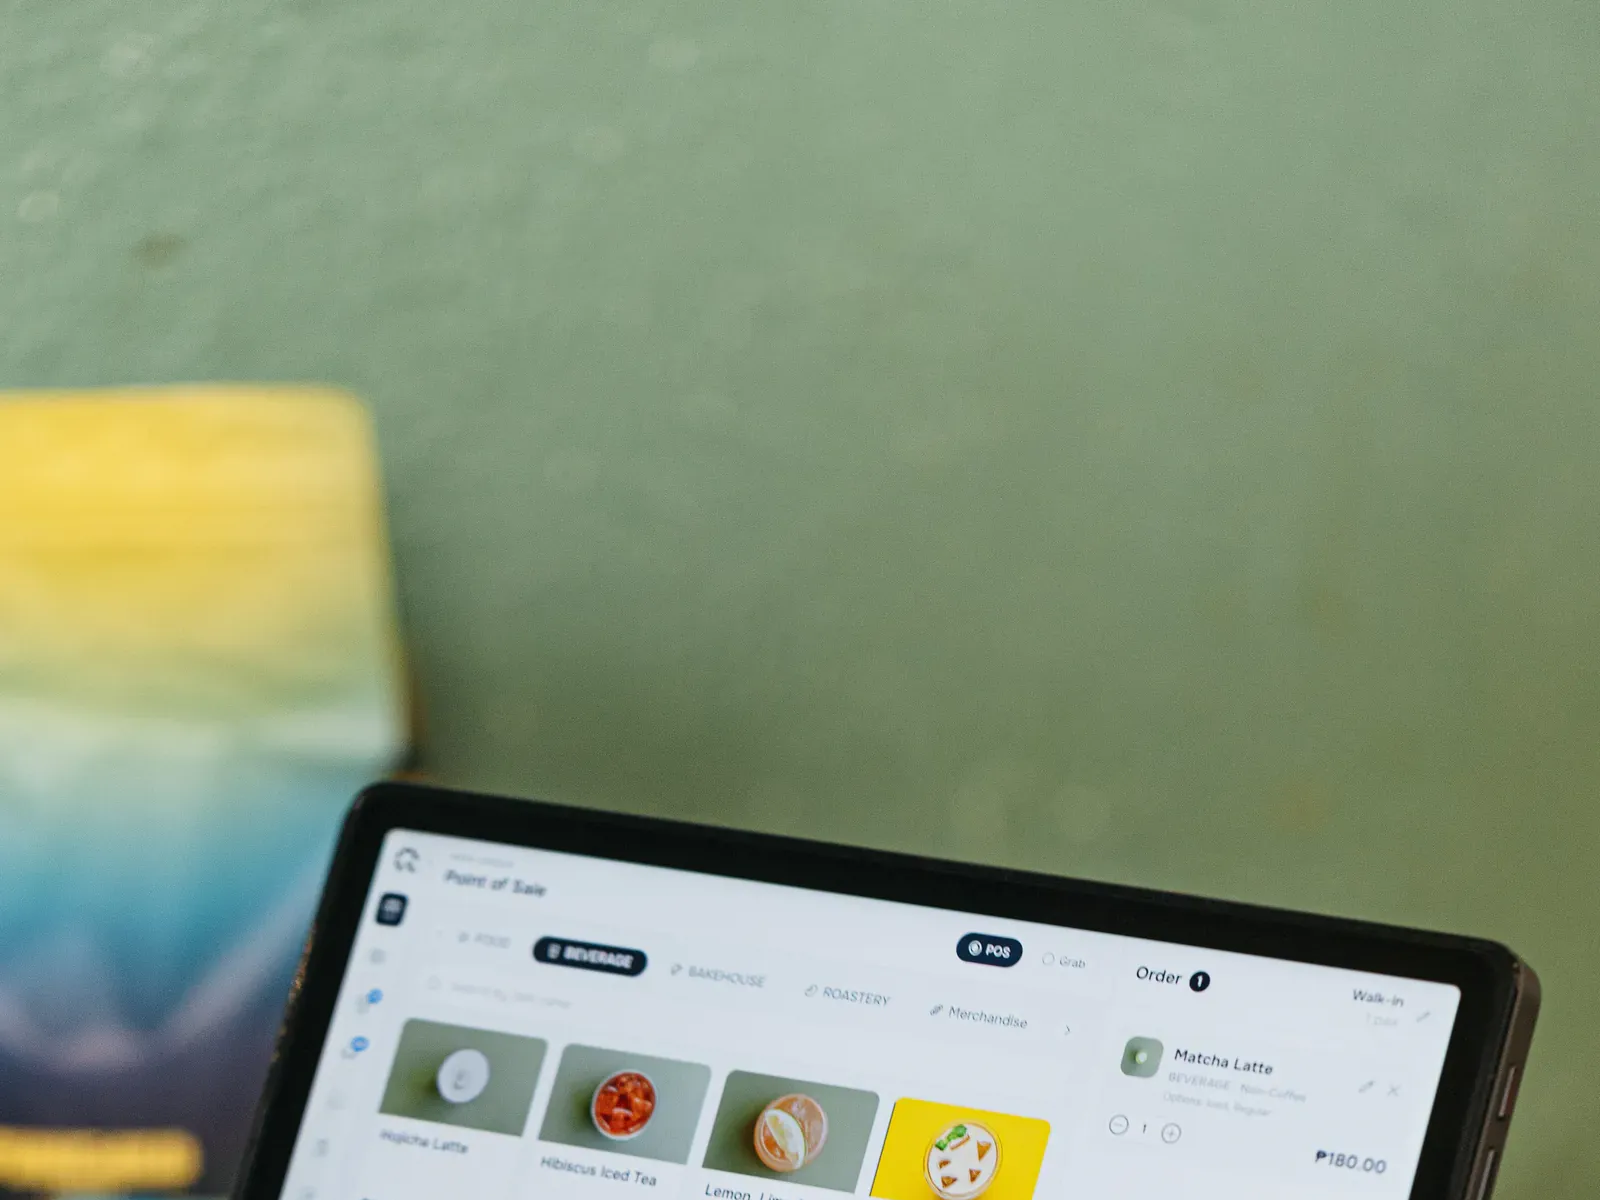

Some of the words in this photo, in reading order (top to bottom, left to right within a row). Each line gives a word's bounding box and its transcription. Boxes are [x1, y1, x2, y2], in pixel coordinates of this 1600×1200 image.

[444, 869, 487, 889] Point
[491, 877, 508, 891] of
[512, 880, 547, 898] Sale
[563, 946, 634, 969] BEVERAGE
[986, 943, 1011, 959] POS
[1059, 956, 1086, 970] Grab
[689, 965, 766, 988] BAKEHOUSE
[1136, 966, 1183, 985] Order
[823, 986, 891, 1007] ROASTERY
[1352, 989, 1405, 1008] Walk-in
[949, 1005, 1028, 1029] Merchandise
[1174, 1048, 1229, 1071] Matcha
[1234, 1057, 1274, 1076] Latte
[1168, 1072, 1231, 1090] BEVERAGE
[540, 1156, 597, 1177] Hibiscus
[601, 1164, 630, 1182] Iced
[635, 1171, 657, 1187] Tea
